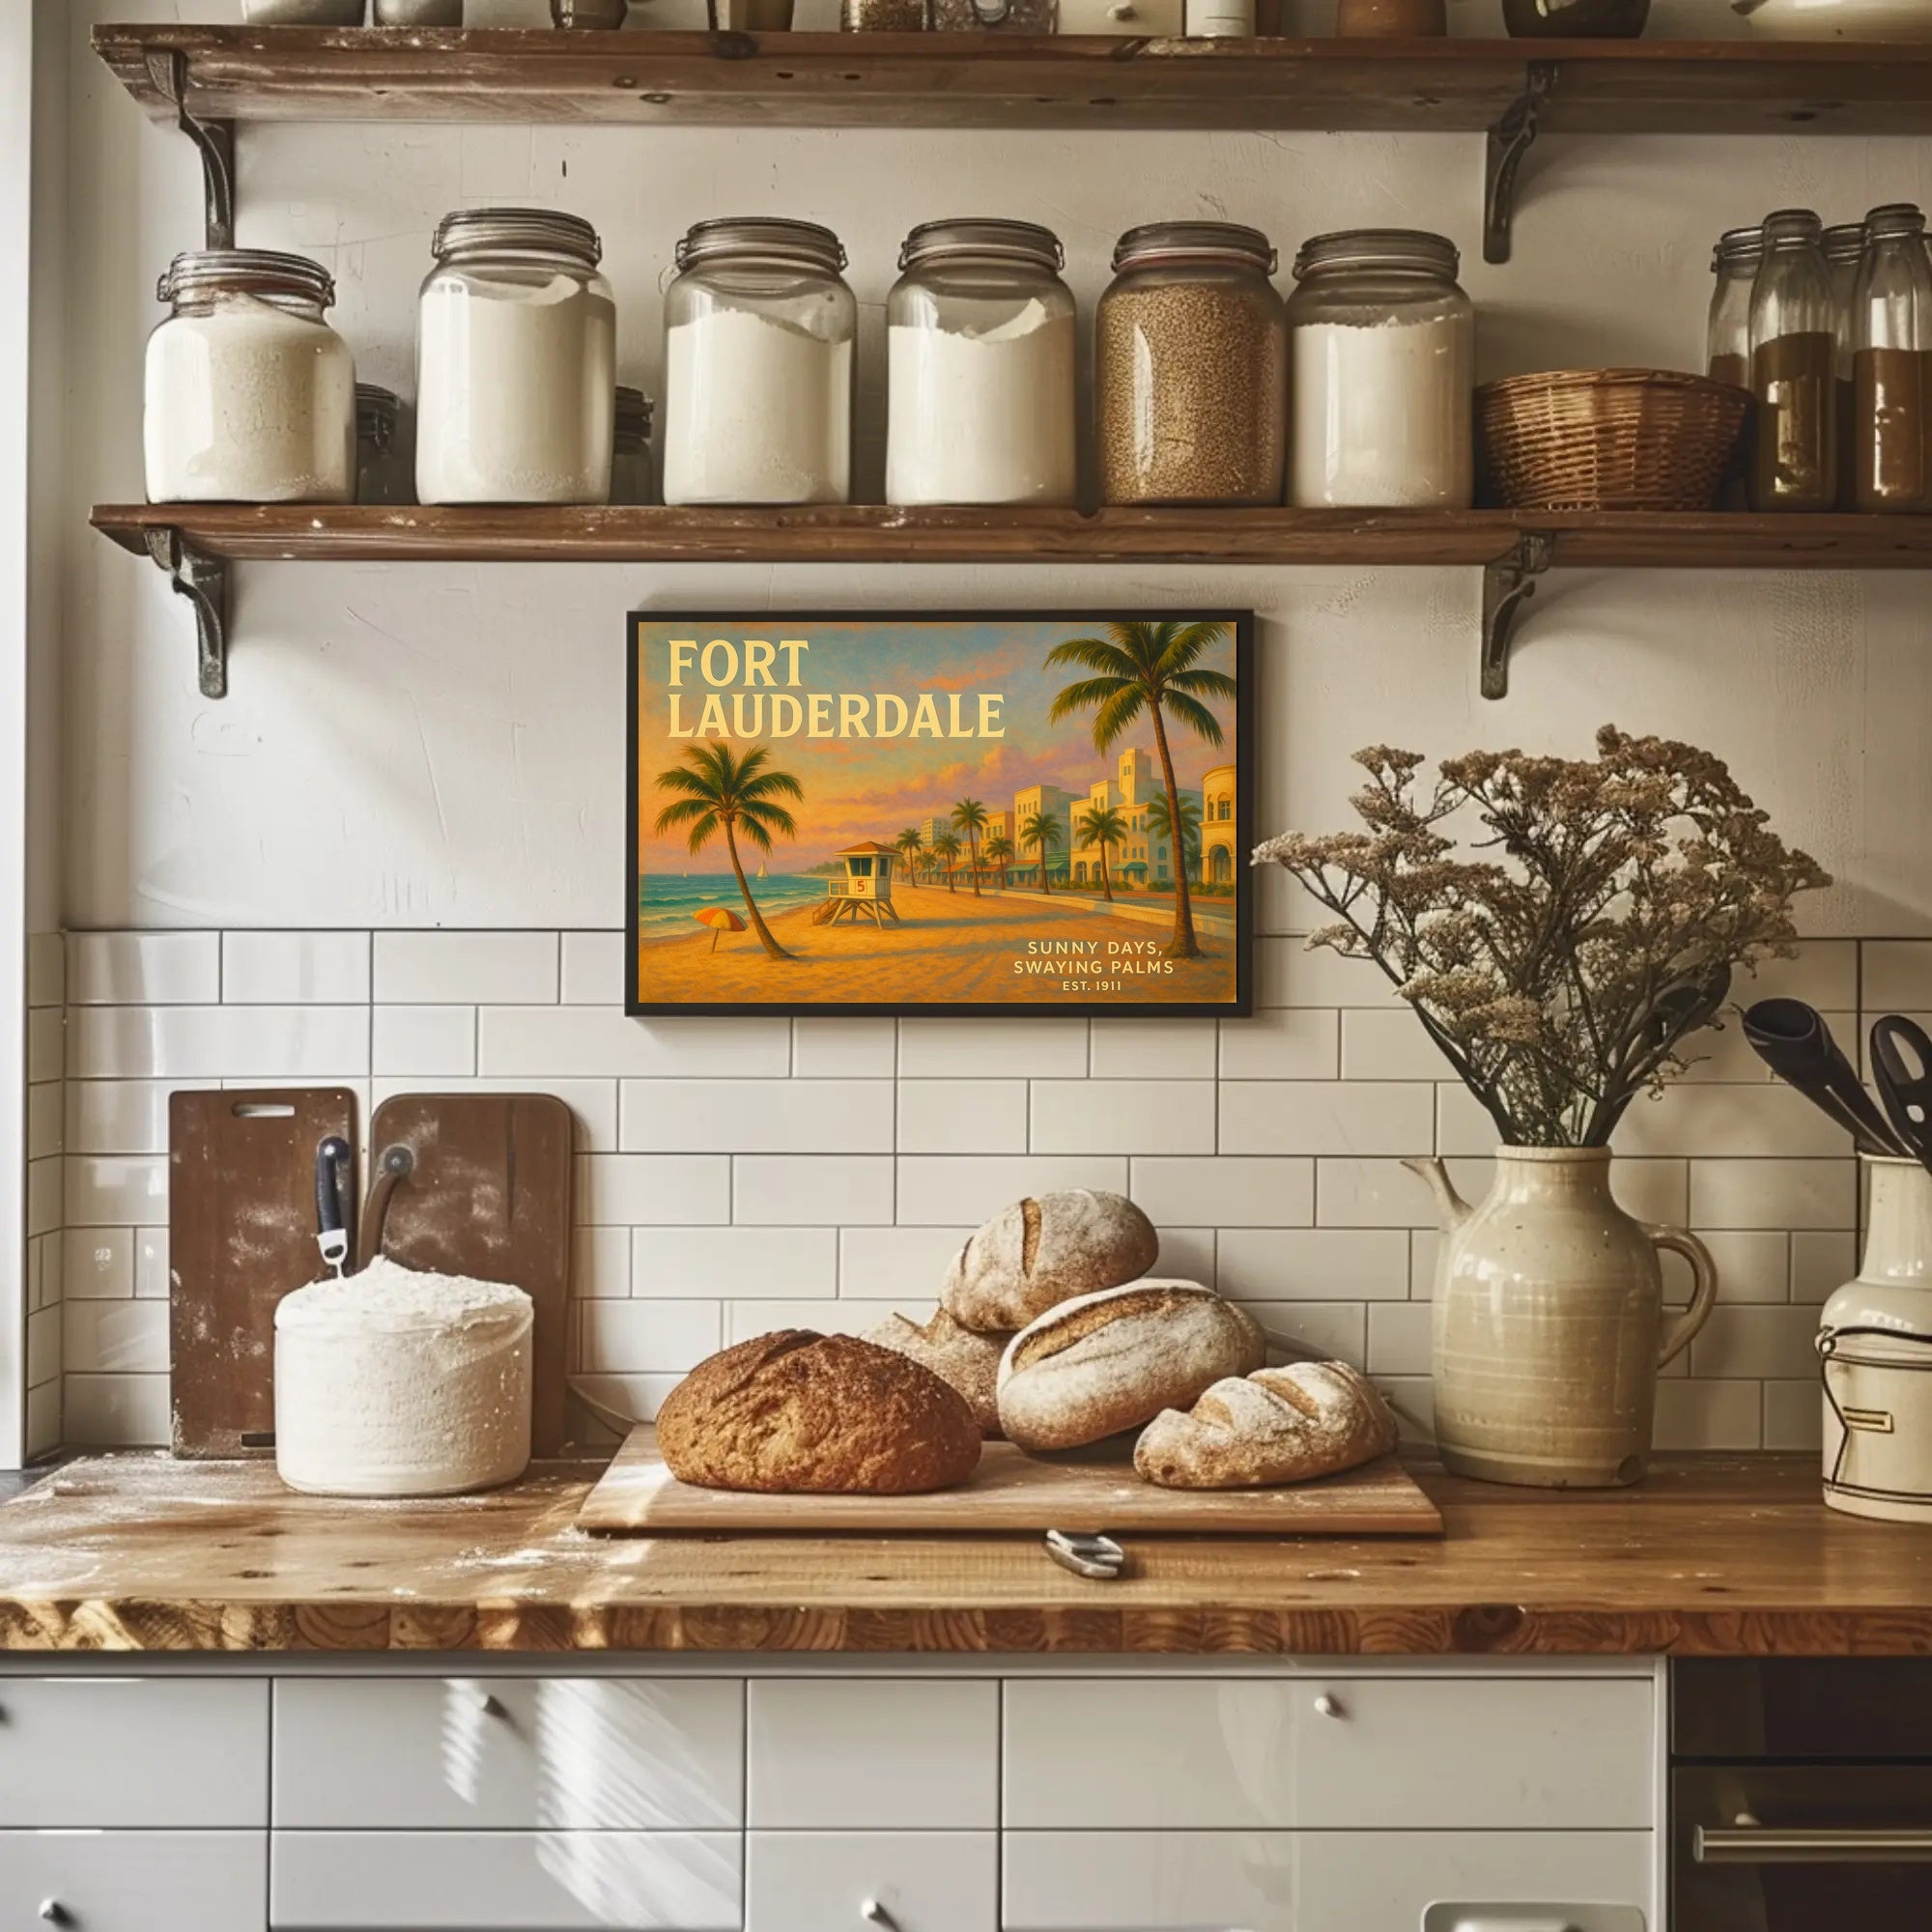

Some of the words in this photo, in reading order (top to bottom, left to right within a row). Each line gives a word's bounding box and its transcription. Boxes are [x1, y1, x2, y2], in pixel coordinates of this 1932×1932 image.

[667, 639, 810, 687] FORT
[667, 694, 1006, 738] LAUDERDALE
[857, 880, 866, 892] 5
[1028, 941, 1098, 954] SUNNY
[1108, 941, 1163, 956] DAYS,
[1013, 960, 1102, 974] SWAYING
[1111, 960, 1175, 974] PALMS
[1062, 980, 1091, 991] EST.
[1095, 980, 1122, 991] 1911
